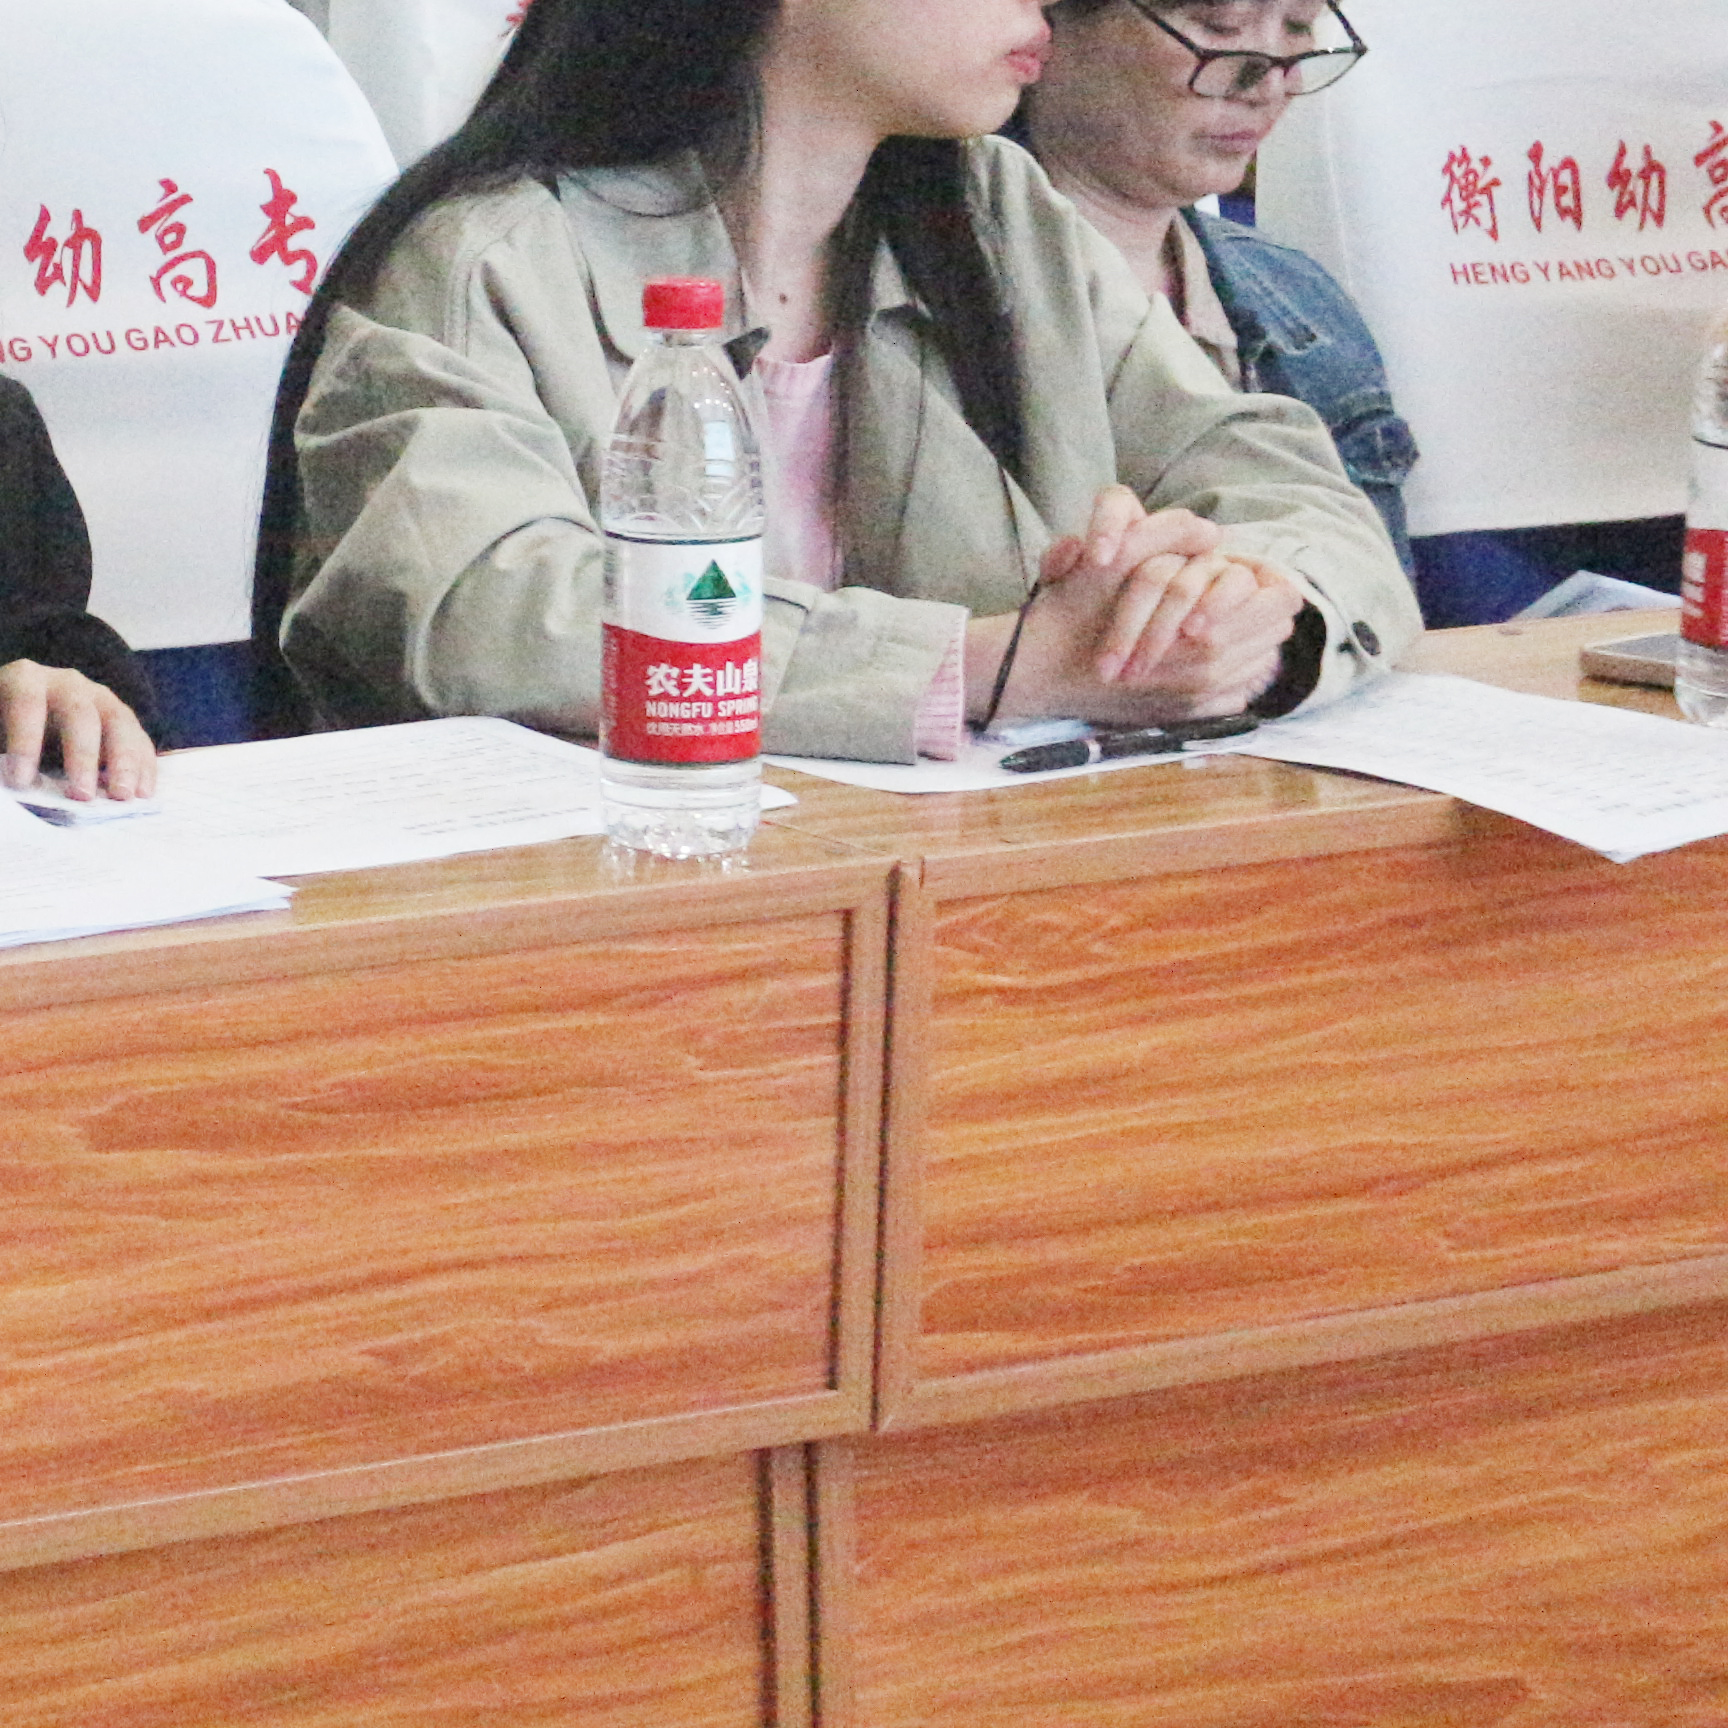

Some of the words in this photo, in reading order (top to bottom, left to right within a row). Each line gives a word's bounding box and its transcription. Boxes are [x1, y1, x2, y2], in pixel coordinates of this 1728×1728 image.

[1449, 261, 1531, 284] HENG
[1533, 257, 1617, 283] YANG
[1617, 254, 1683, 277] YOU
[1686, 248, 1728, 273] GA
[38, 330, 117, 360] YOU
[124, 321, 200, 351] GAO
[645, 657, 759, 698] 农夫山泉
[645, 700, 714, 719] NONGFU
